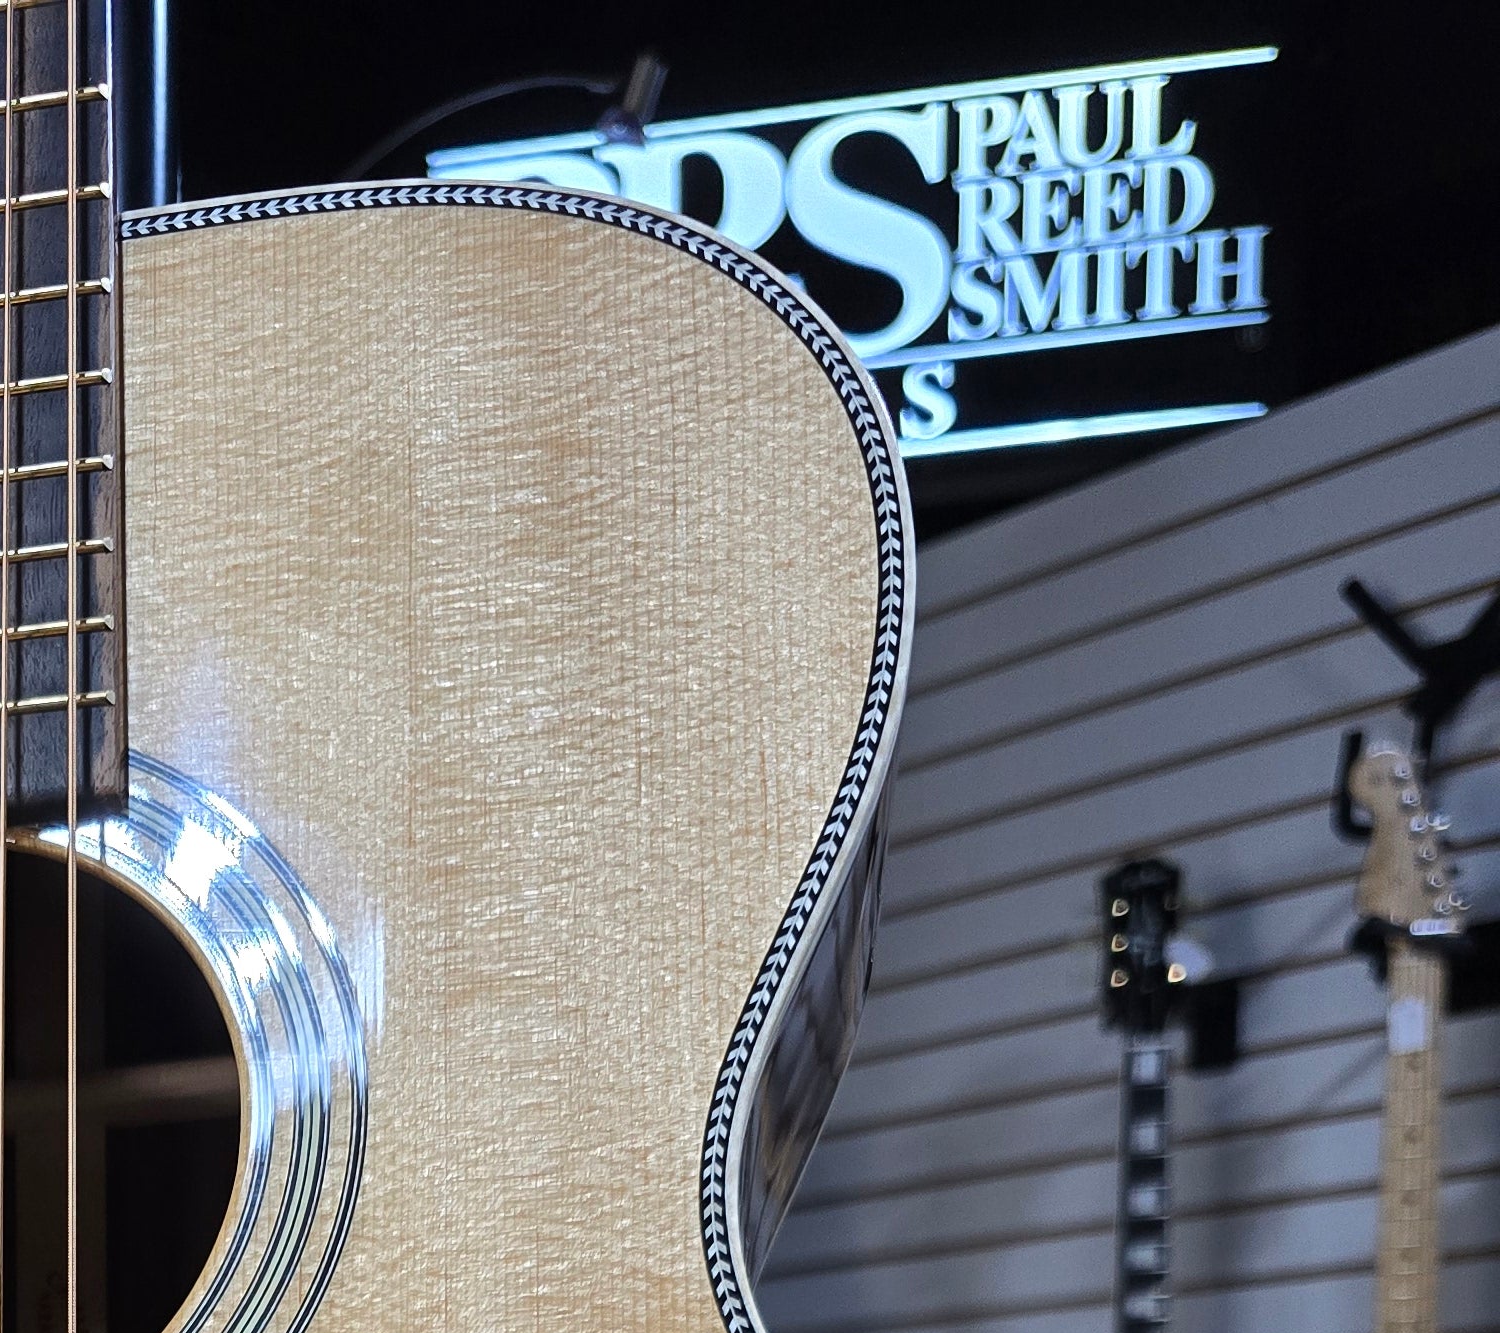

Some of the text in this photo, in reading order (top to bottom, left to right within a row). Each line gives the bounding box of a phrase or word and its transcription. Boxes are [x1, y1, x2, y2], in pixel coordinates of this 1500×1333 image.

[951, 74, 1198, 180] PAUL
[952, 154, 1217, 264] REED
[947, 224, 1272, 343] SMITH
